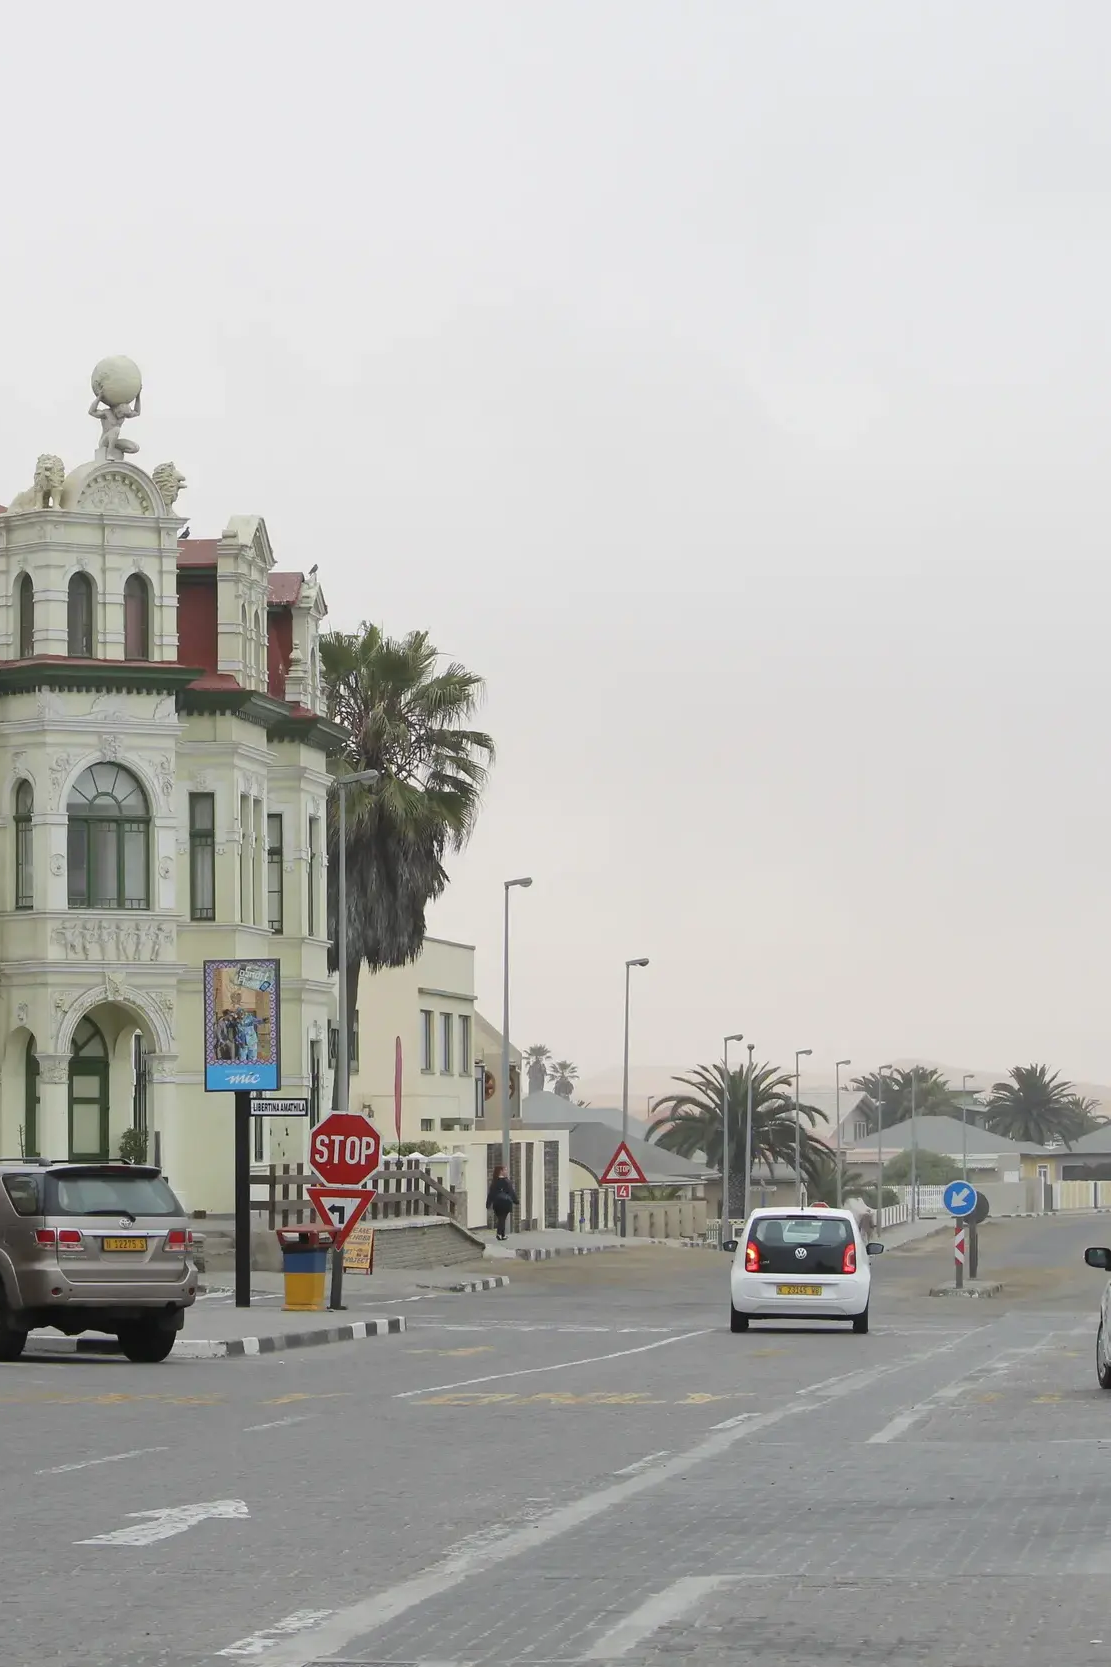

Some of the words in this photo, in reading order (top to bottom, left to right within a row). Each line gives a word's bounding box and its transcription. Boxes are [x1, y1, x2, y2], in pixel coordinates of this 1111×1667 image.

[253, 1102, 280, 1112] LIBERTINA
[280, 1102, 306, 1112] AMATHILA
[314, 1134, 376, 1165] STOP
[615, 1165, 630, 1173] STOP
[619, 1186, 627, 1197] 4
[139, 1239, 145, 1249] S
